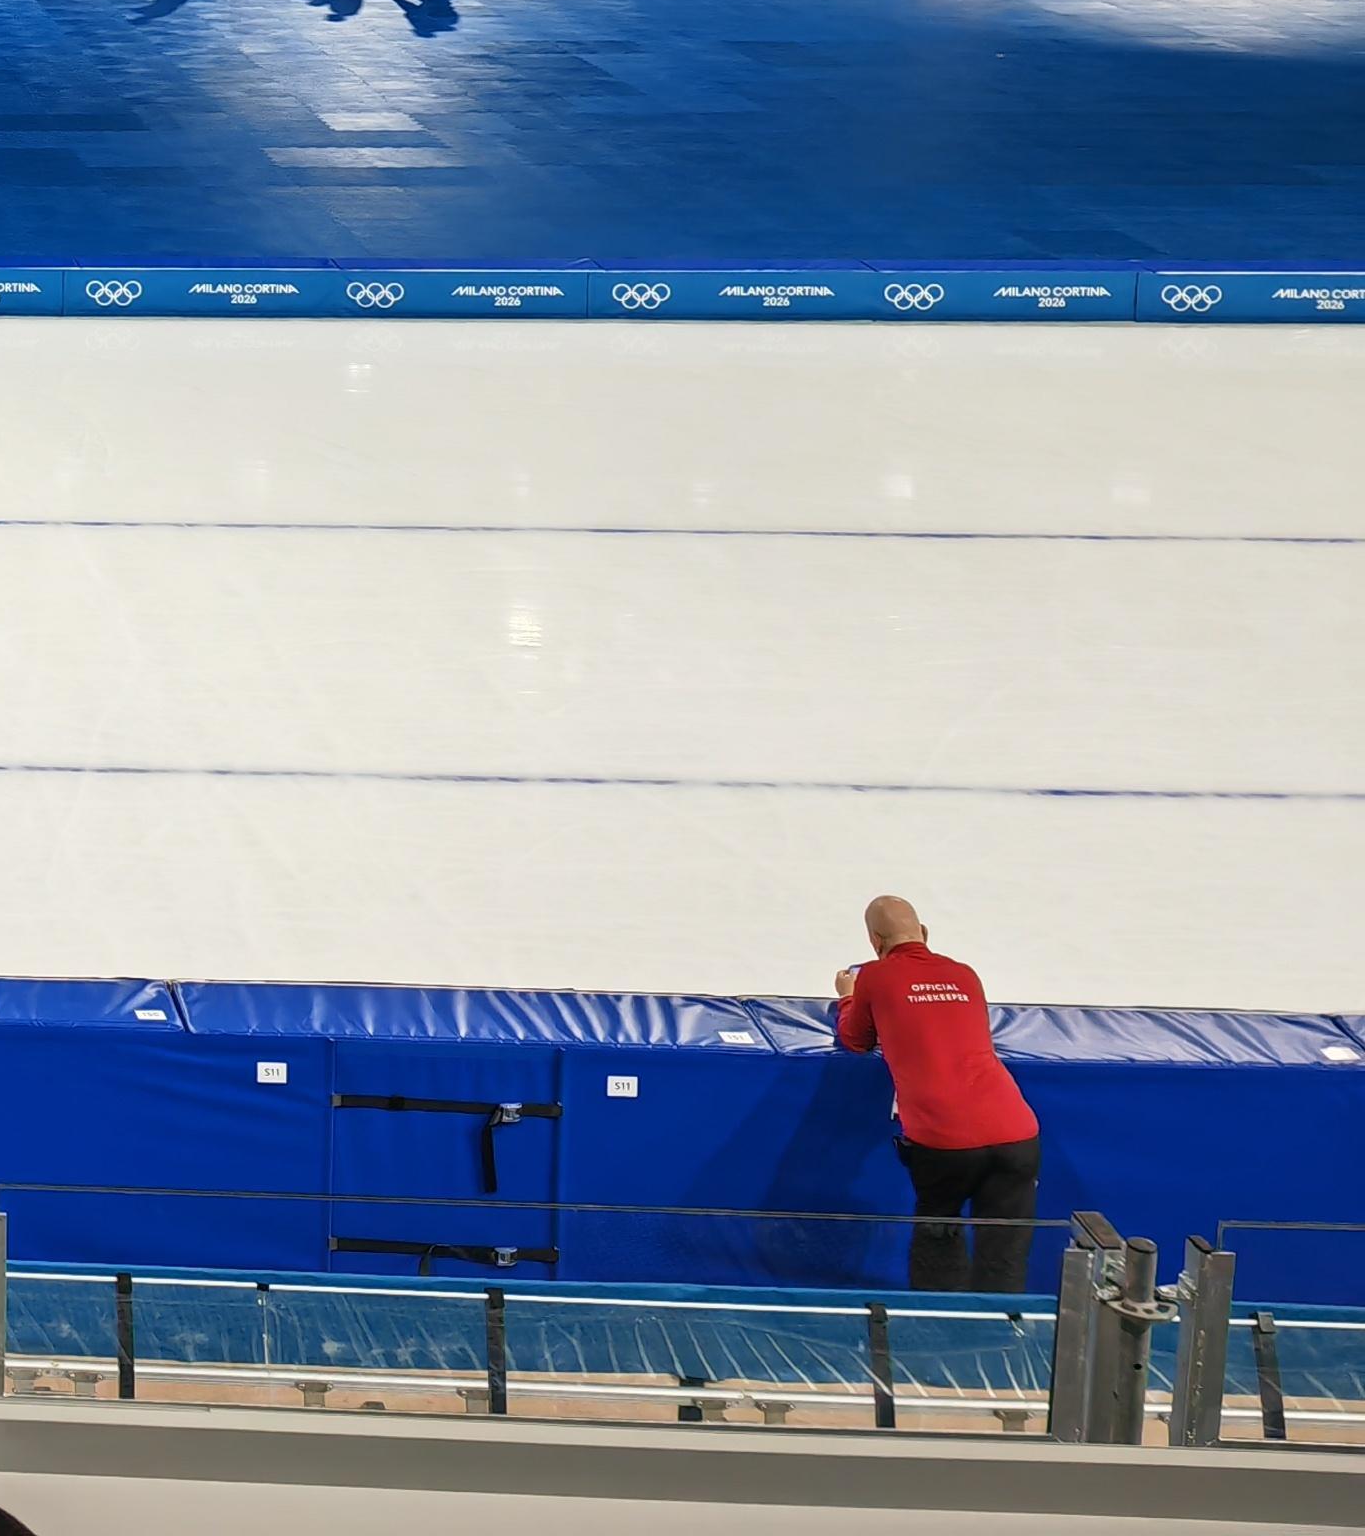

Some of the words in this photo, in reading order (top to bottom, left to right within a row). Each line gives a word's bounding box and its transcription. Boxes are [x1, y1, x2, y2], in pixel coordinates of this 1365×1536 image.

[188, 283, 242, 294] MILANO
[244, 283, 300, 294] CORTINA
[451, 285, 506, 297] MILANO
[508, 285, 565, 297] CORTINA
[718, 285, 775, 297] MILANO
[777, 285, 835, 297] CORTINA
[993, 286, 1050, 298] MILANO
[1052, 286, 1111, 298] CORTINA
[1272, 288, 1330, 300] MILANO
[230, 293, 258, 304] 2026
[494, 295, 522, 307] 2026
[762, 296, 790, 307] 2026
[1037, 296, 1066, 308] 2026
[1316, 299, 1345, 310] 2026
[911, 982, 960, 993] OFFICIAL
[906, 993, 970, 1003] TIMEKEEPER
[264, 1066, 281, 1078] S11
[614, 1081, 632, 1092] S11
